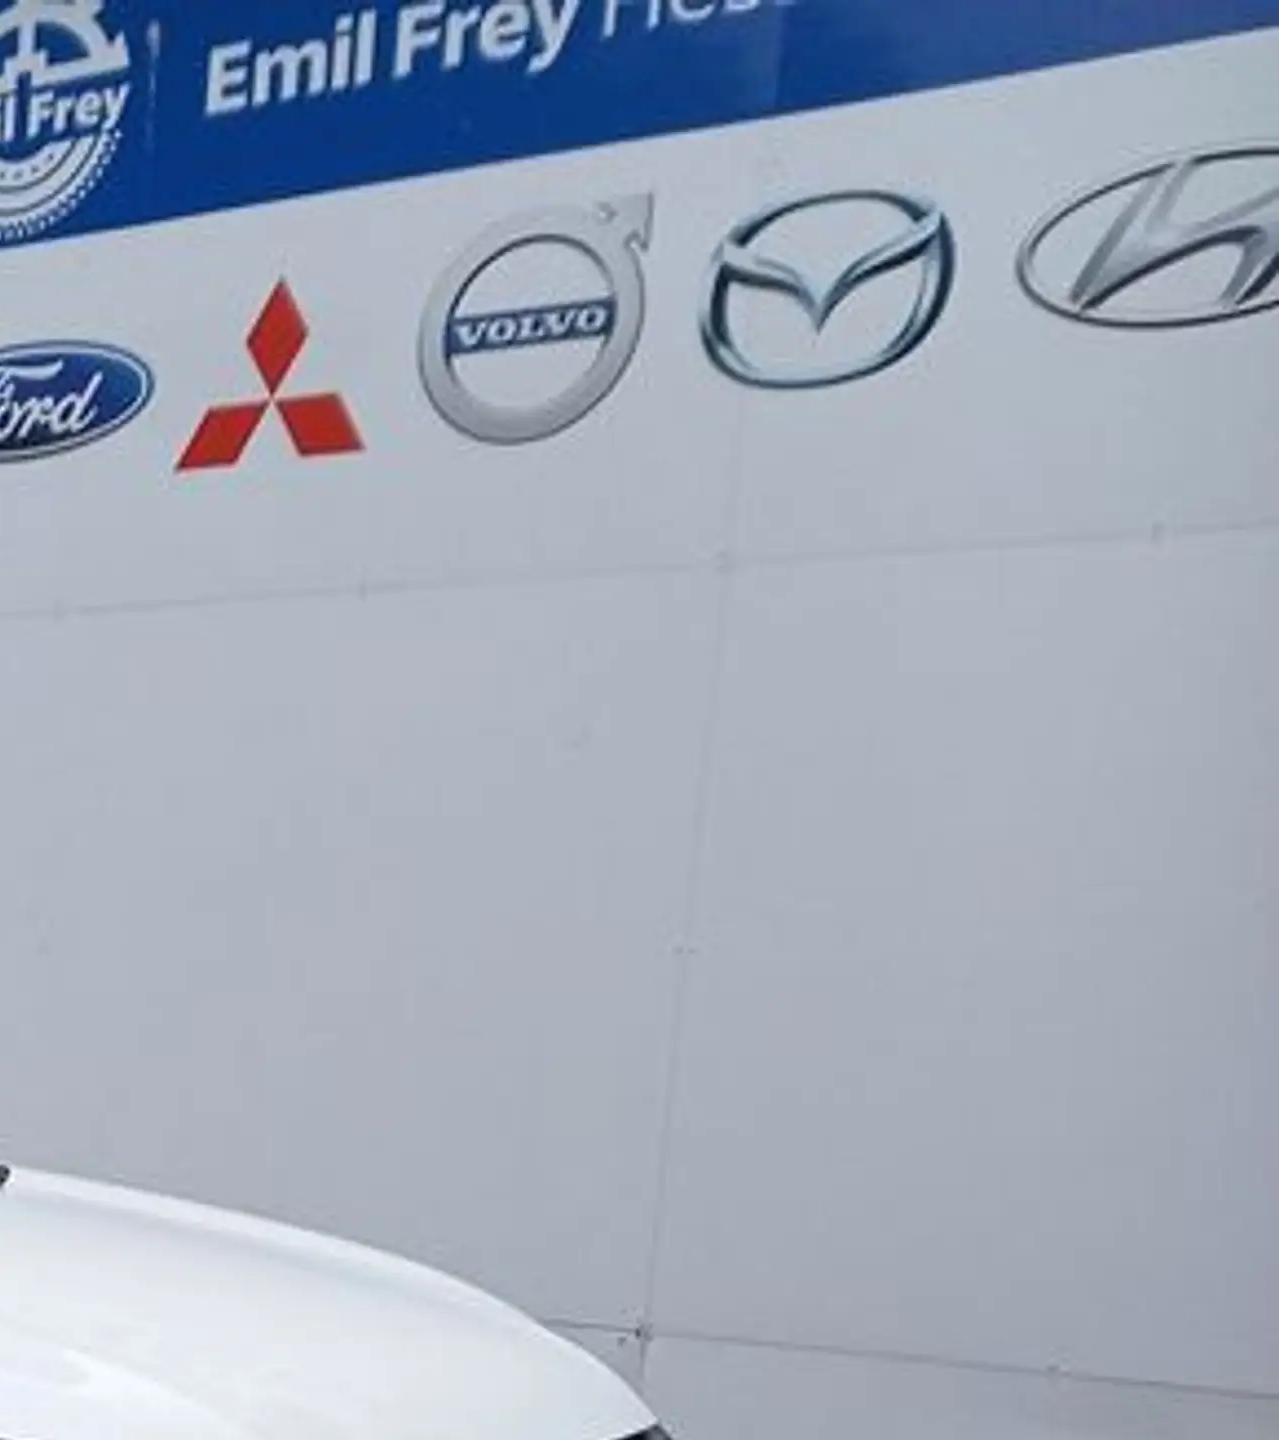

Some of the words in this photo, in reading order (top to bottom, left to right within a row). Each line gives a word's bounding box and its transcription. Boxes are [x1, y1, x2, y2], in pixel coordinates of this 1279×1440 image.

[205, 9, 378, 117] Emil
[393, 0, 578, 76] Frey
[25, 84, 131, 142] Frey
[454, 303, 609, 348] VOLVO
